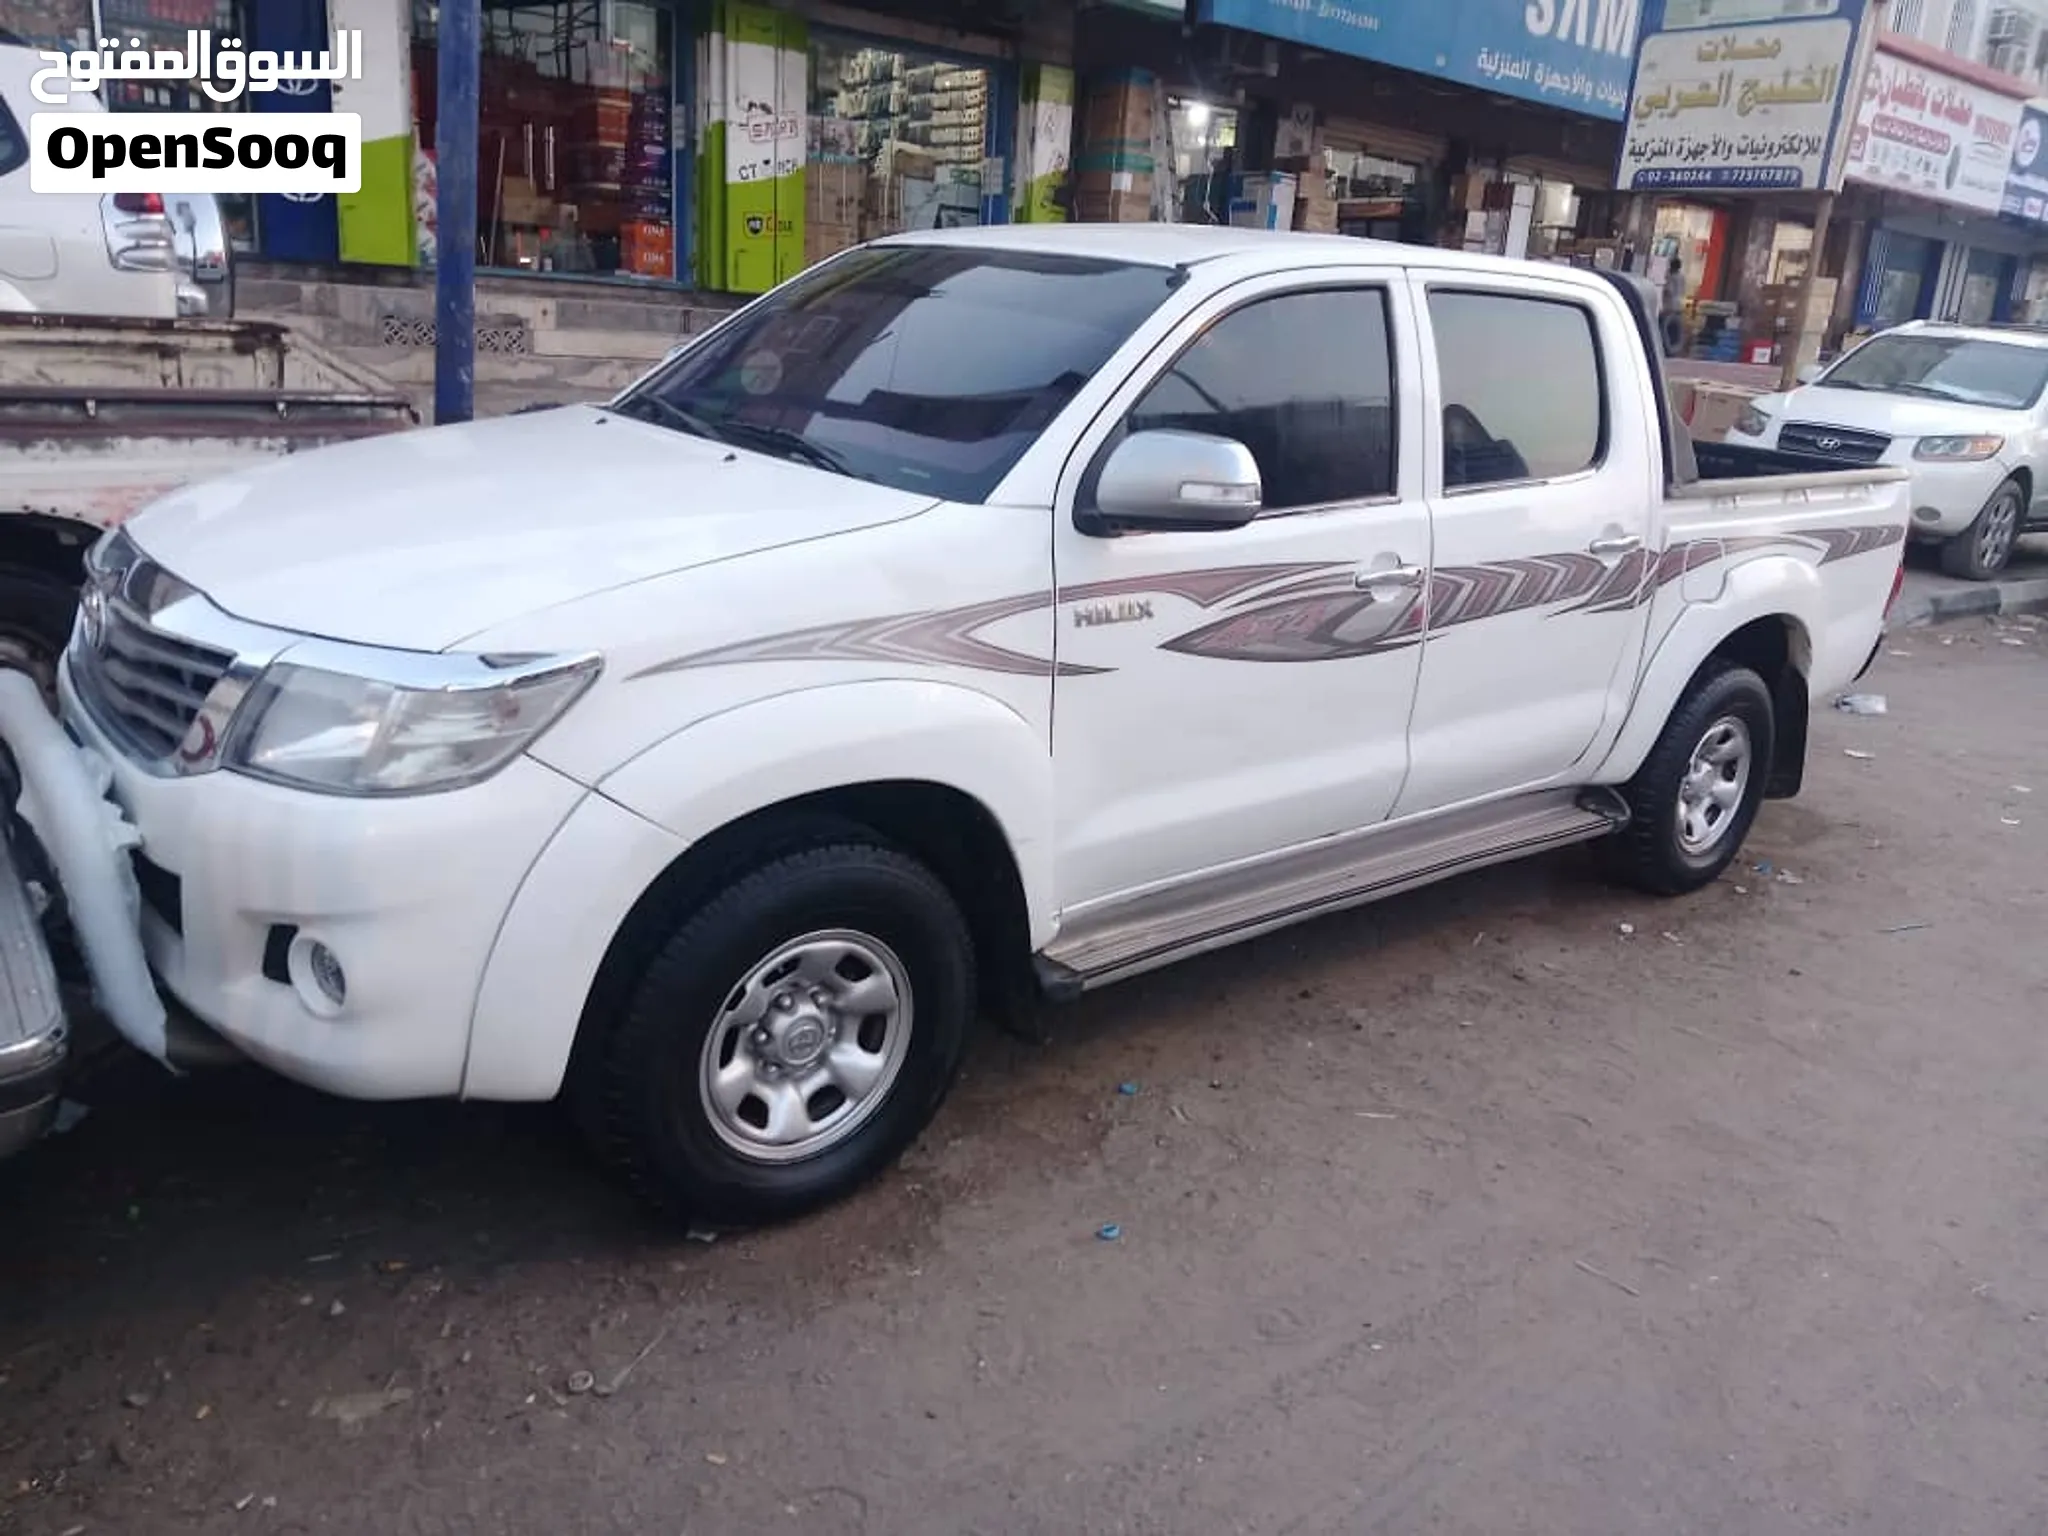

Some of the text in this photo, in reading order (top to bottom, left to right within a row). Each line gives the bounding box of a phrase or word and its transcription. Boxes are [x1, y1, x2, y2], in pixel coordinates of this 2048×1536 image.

[1697, 34, 1782, 62] محلات
[1736, 63, 1838, 118] الخليج
[1073, 599, 1154, 628] HILUX
